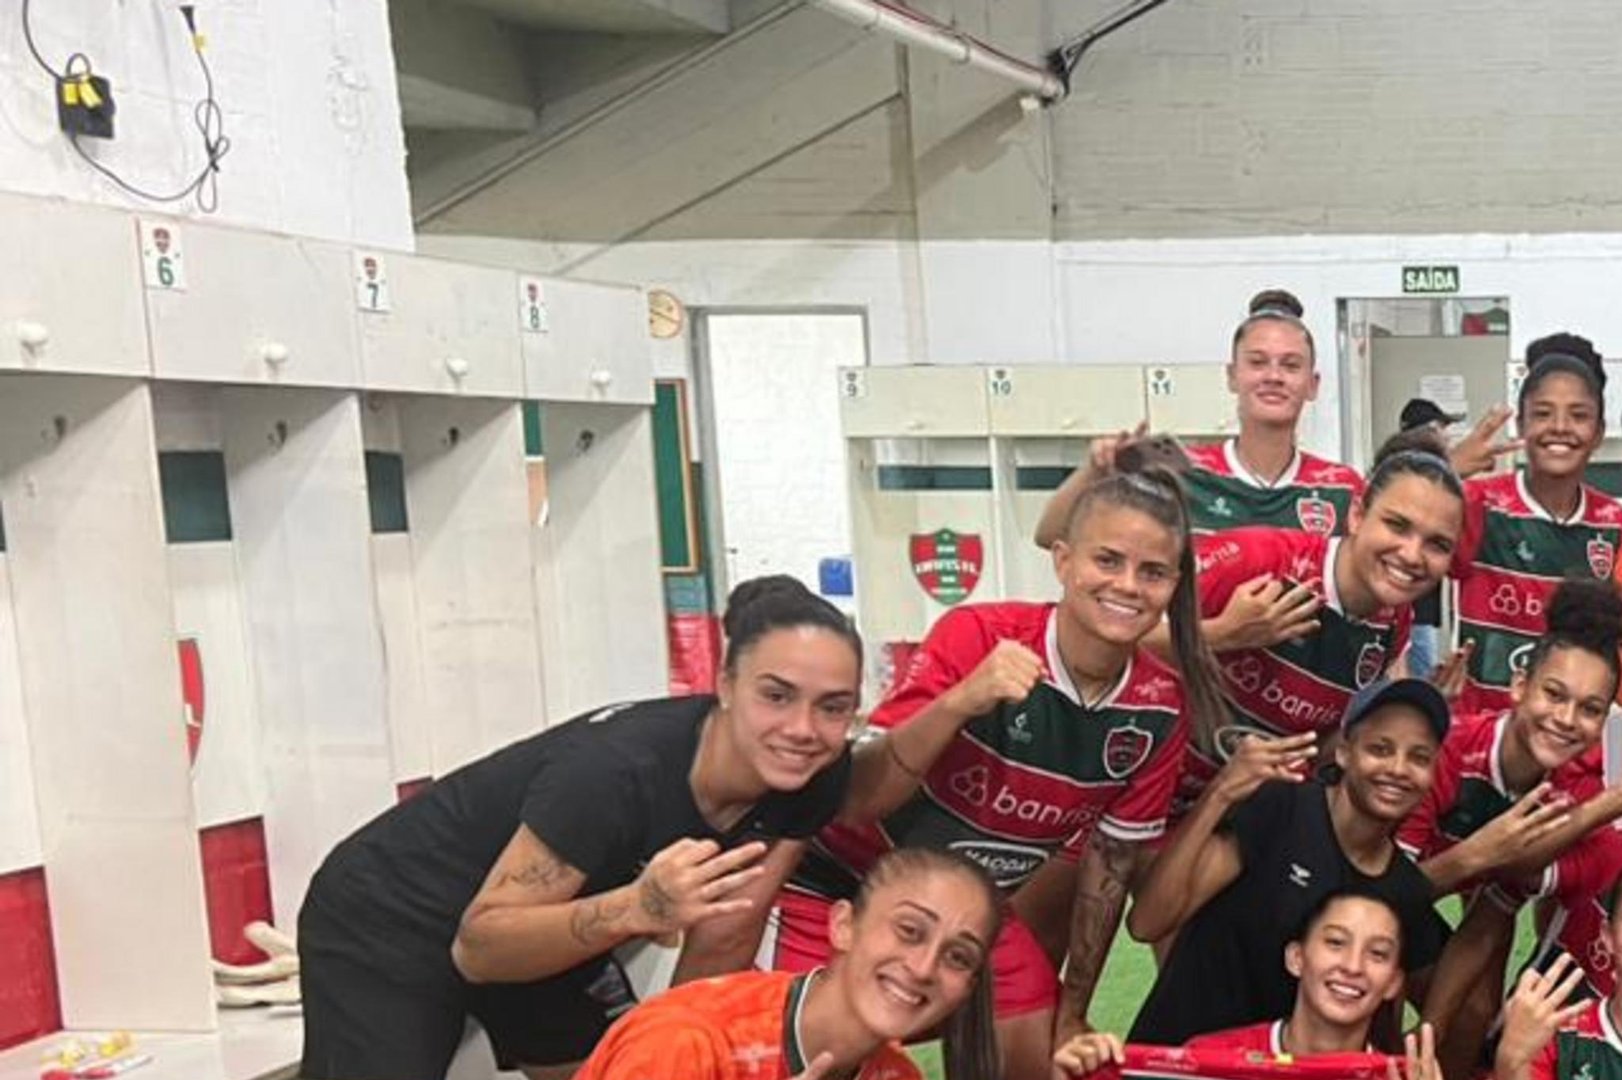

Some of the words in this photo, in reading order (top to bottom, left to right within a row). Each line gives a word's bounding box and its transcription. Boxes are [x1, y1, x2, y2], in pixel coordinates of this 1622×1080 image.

[157, 256, 174, 287] 6
[1405, 268, 1457, 290] SAÍDA
[367, 282, 379, 309] 7
[529, 305, 540, 329] 8
[846, 381, 858, 397] 9
[992, 381, 1012, 395] 10
[1152, 381, 1171, 395] 11
